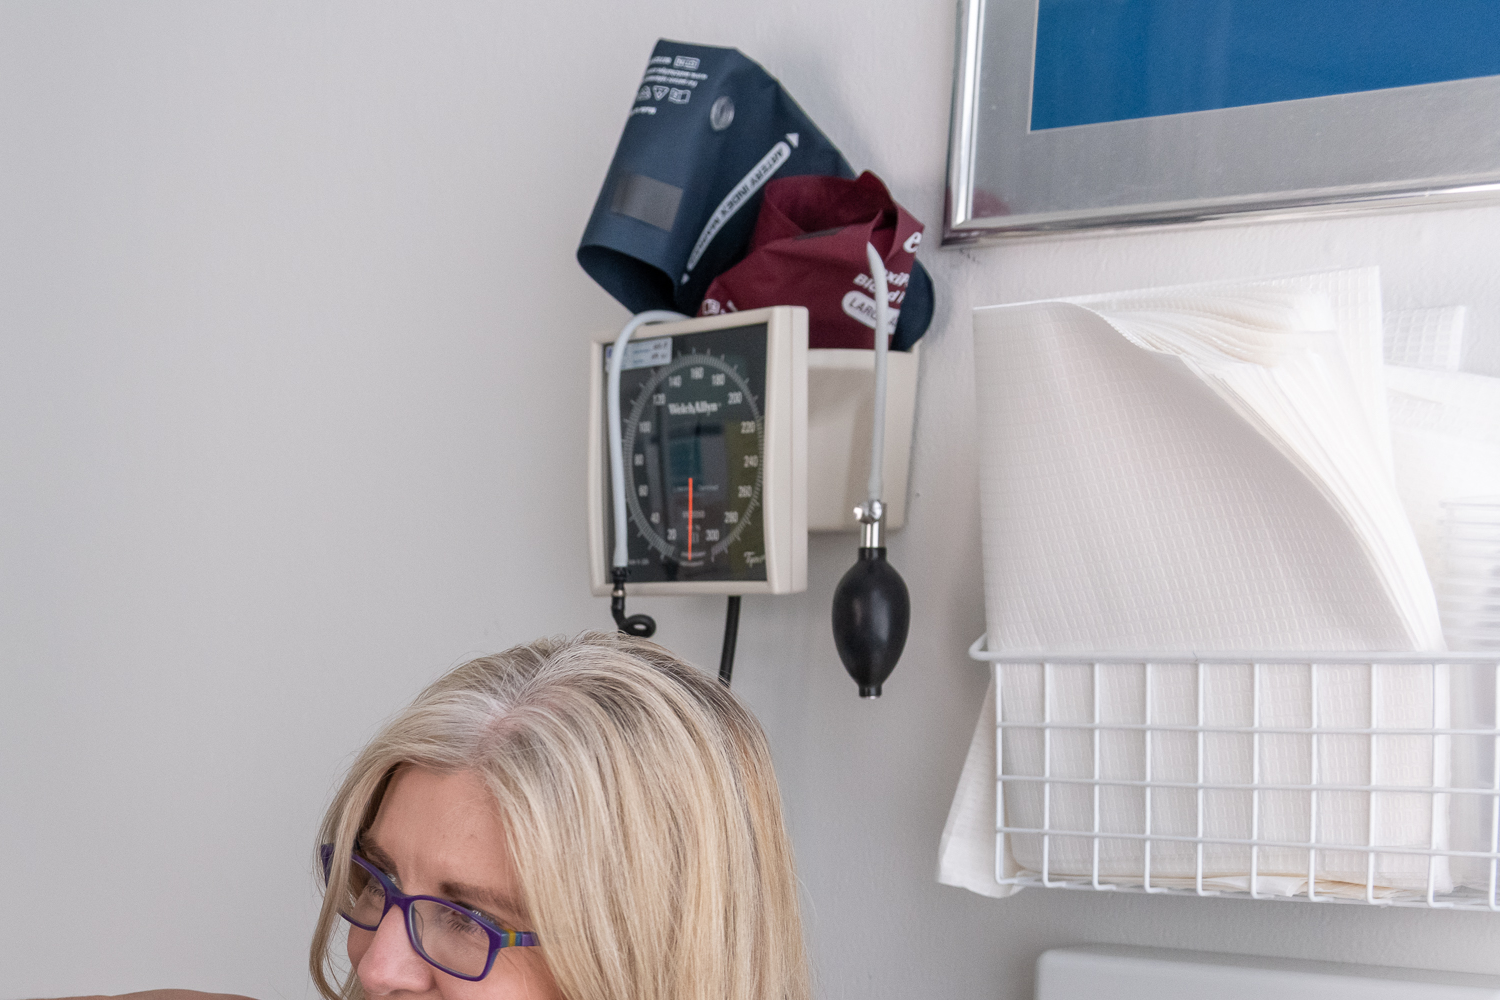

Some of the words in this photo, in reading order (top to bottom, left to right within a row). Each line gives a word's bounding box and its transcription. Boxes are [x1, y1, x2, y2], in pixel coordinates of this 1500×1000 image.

[751, 148, 784, 188] ARTERY
[721, 186, 750, 218] INDEX
[690, 366, 704, 380] 160
[711, 373, 725, 386] 180
[668, 374, 682, 388] 140
[653, 392, 666, 405] 120
[728, 391, 742, 405] 200
[639, 420, 652, 433] 100
[740, 420, 755, 434] 220
[634, 453, 644, 466] 80
[743, 455, 758, 468] 240
[638, 484, 648, 497] 60
[738, 485, 752, 498] 260
[650, 511, 660, 524] 40
[724, 511, 738, 523] 280
[667, 528, 677, 541] 20
[705, 529, 719, 541] 300
